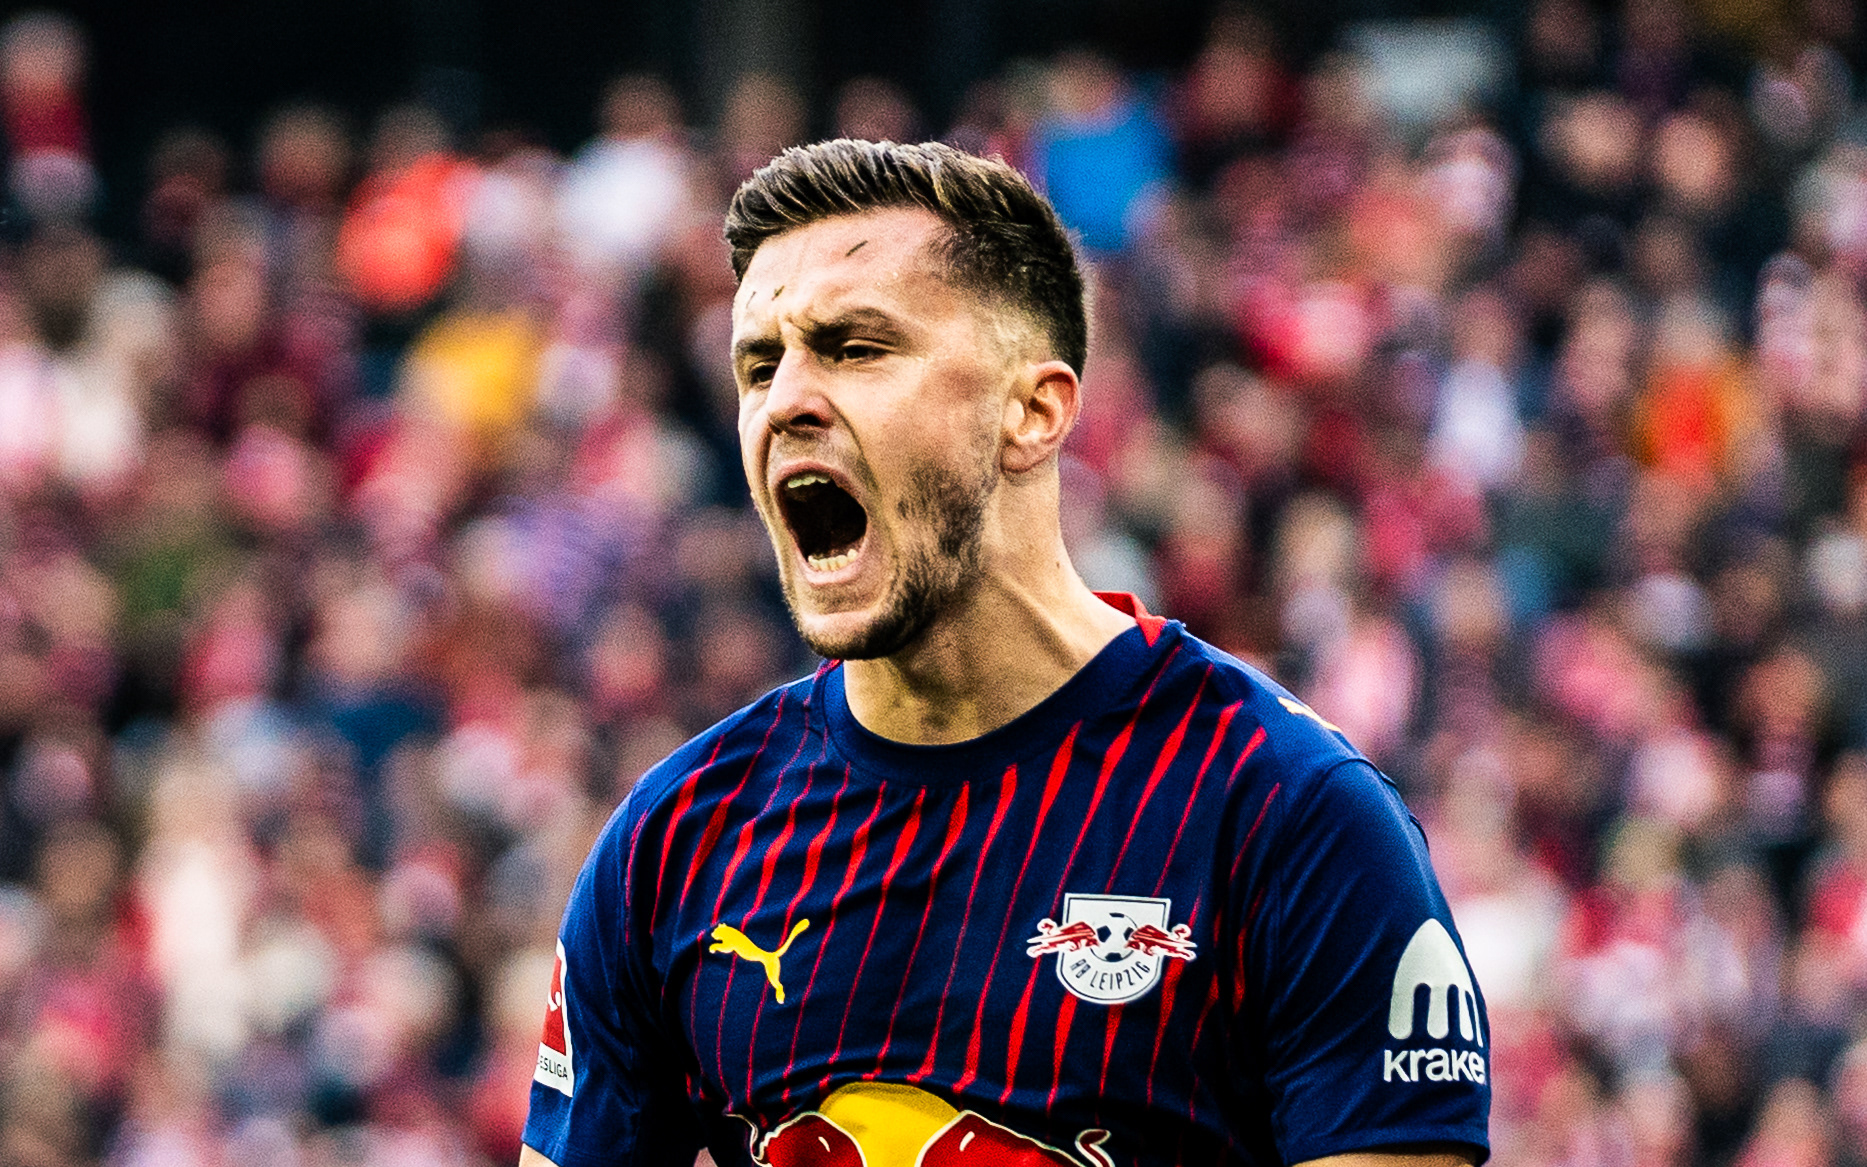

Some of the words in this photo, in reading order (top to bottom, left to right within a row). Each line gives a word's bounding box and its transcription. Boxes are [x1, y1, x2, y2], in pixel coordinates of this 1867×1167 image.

[1089, 961, 1151, 991] LEIPZIG
[538, 1055, 569, 1080] ESLIGA
[1383, 1047, 1487, 1086] krake
